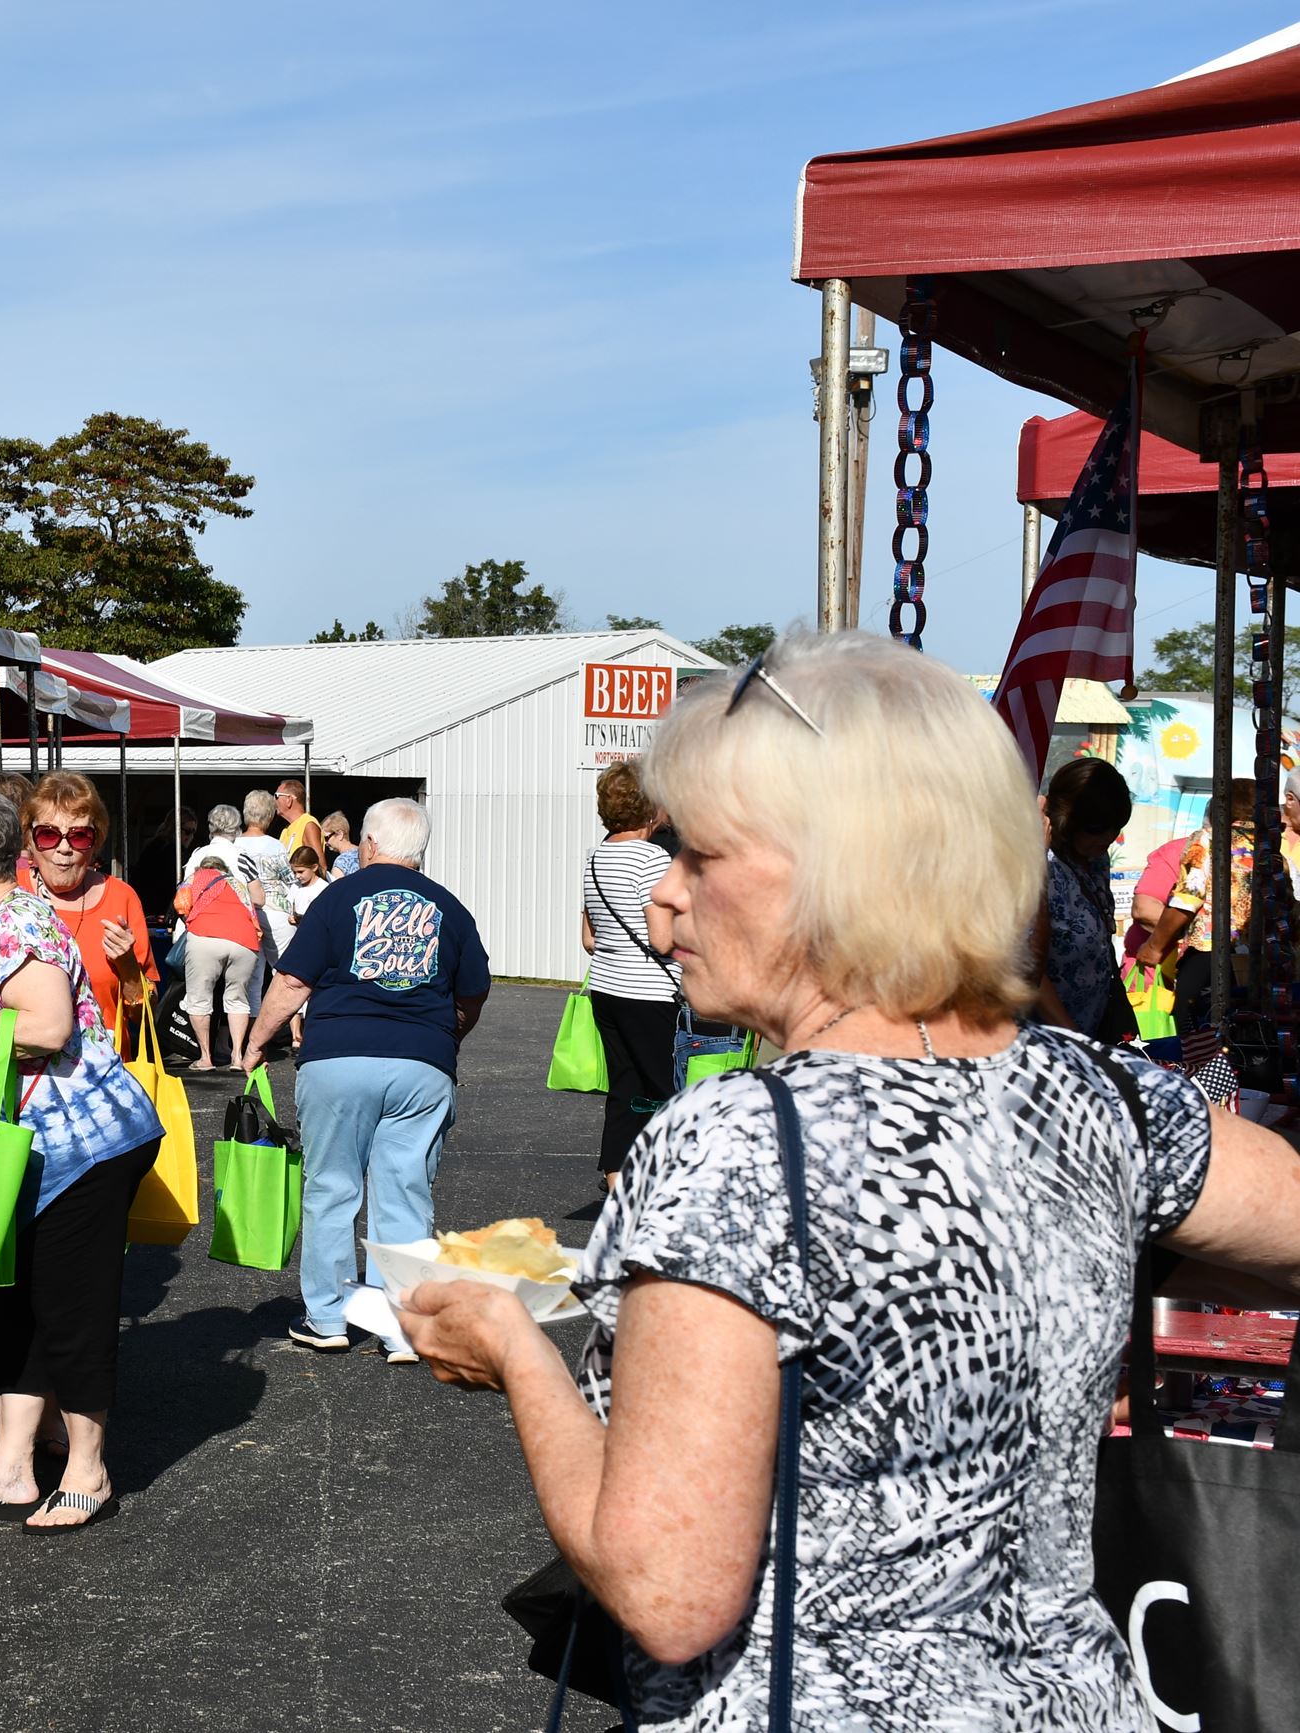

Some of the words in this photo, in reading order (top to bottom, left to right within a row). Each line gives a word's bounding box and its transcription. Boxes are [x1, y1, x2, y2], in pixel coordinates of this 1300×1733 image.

[591, 668, 667, 715] BEEF
[585, 724, 607, 747] IT'S
[358, 900, 436, 941] Well
[356, 937, 439, 980] Soul
[394, 943, 416, 953] MY
